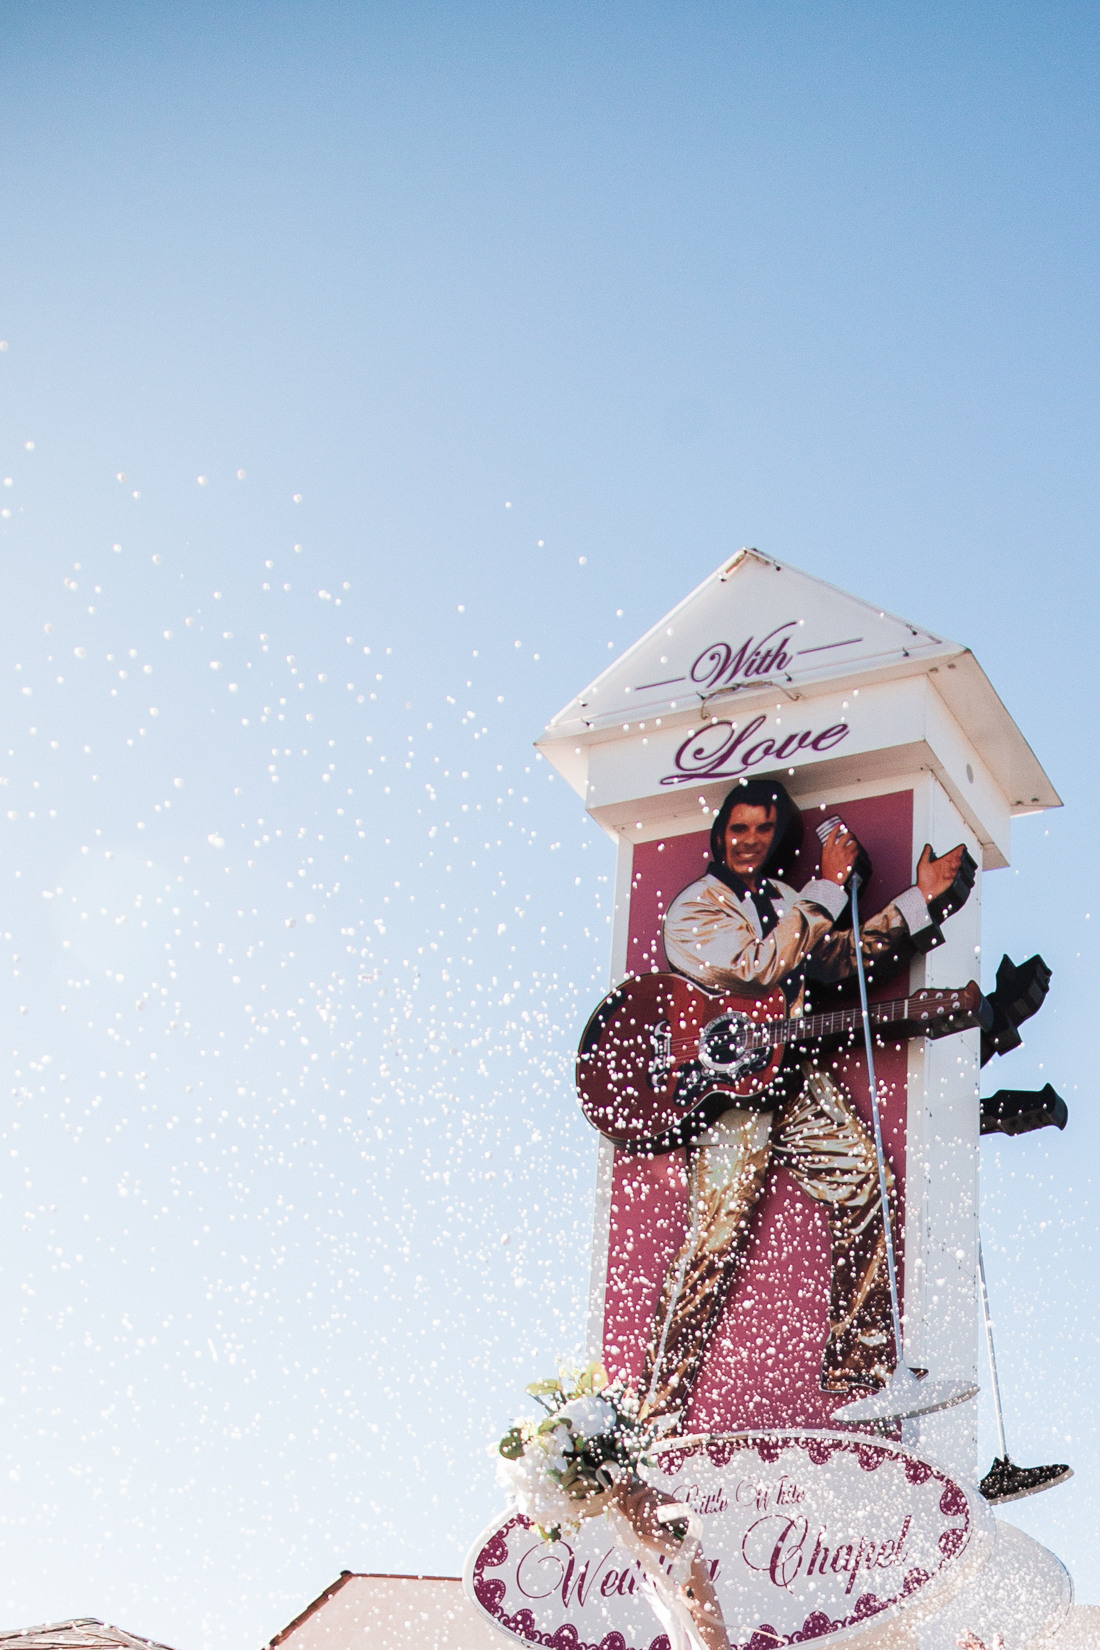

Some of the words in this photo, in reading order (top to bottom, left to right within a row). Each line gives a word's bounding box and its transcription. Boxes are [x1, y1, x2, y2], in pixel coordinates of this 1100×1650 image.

[690, 621, 797, 688] With
[660, 715, 850, 785] Love
[742, 1514, 913, 1595] Chapel
